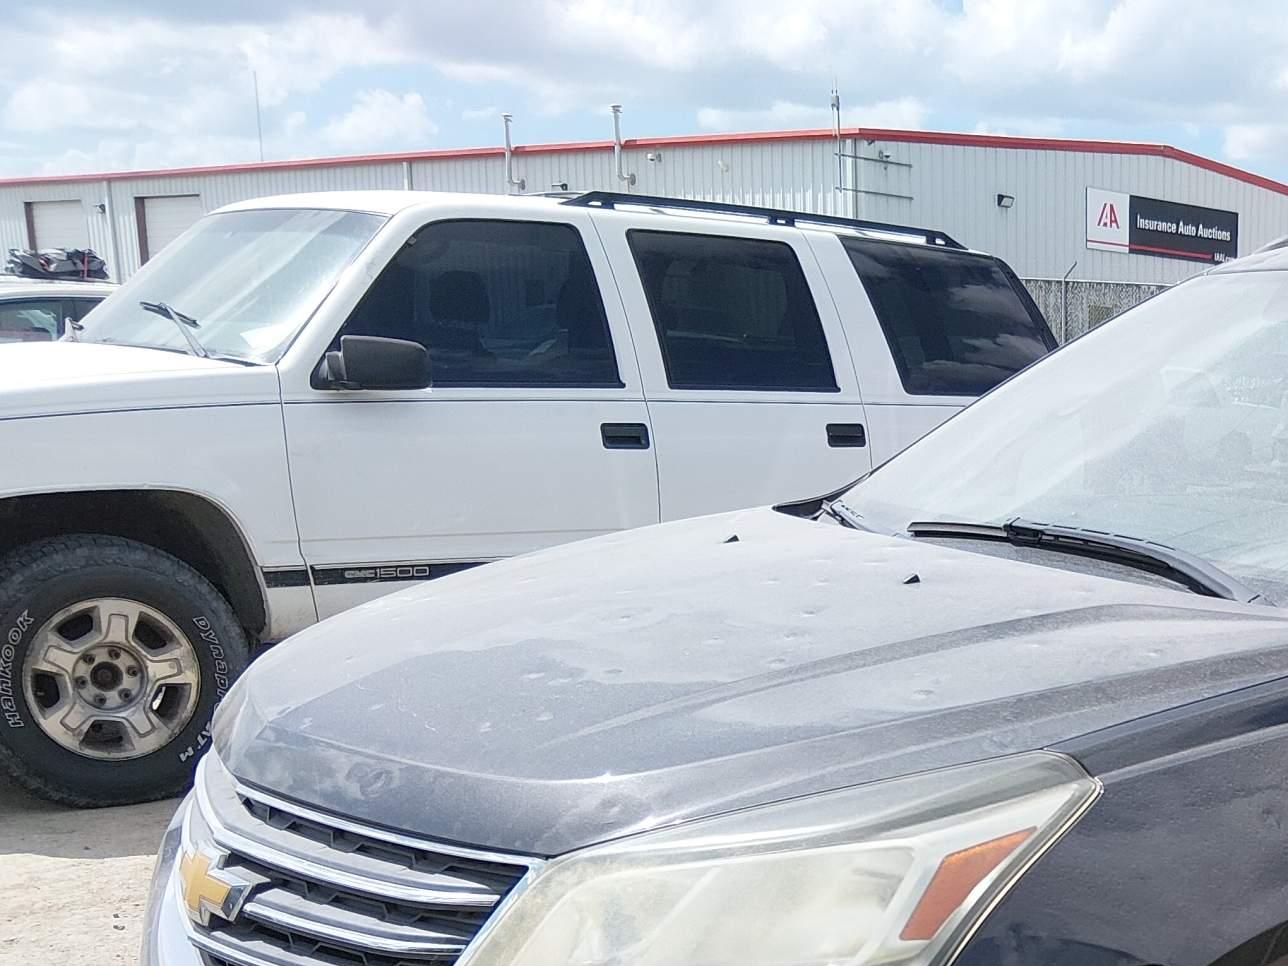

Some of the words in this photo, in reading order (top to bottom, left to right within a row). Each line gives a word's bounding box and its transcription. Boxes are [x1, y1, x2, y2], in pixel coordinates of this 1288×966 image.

[1137, 214, 1176, 233] Insurance
[1178, 220, 1196, 237] Auto
[1198, 224, 1231, 241] Auctions
[376, 567, 429, 578] 1500
[192, 616, 229, 711] Dynapr
